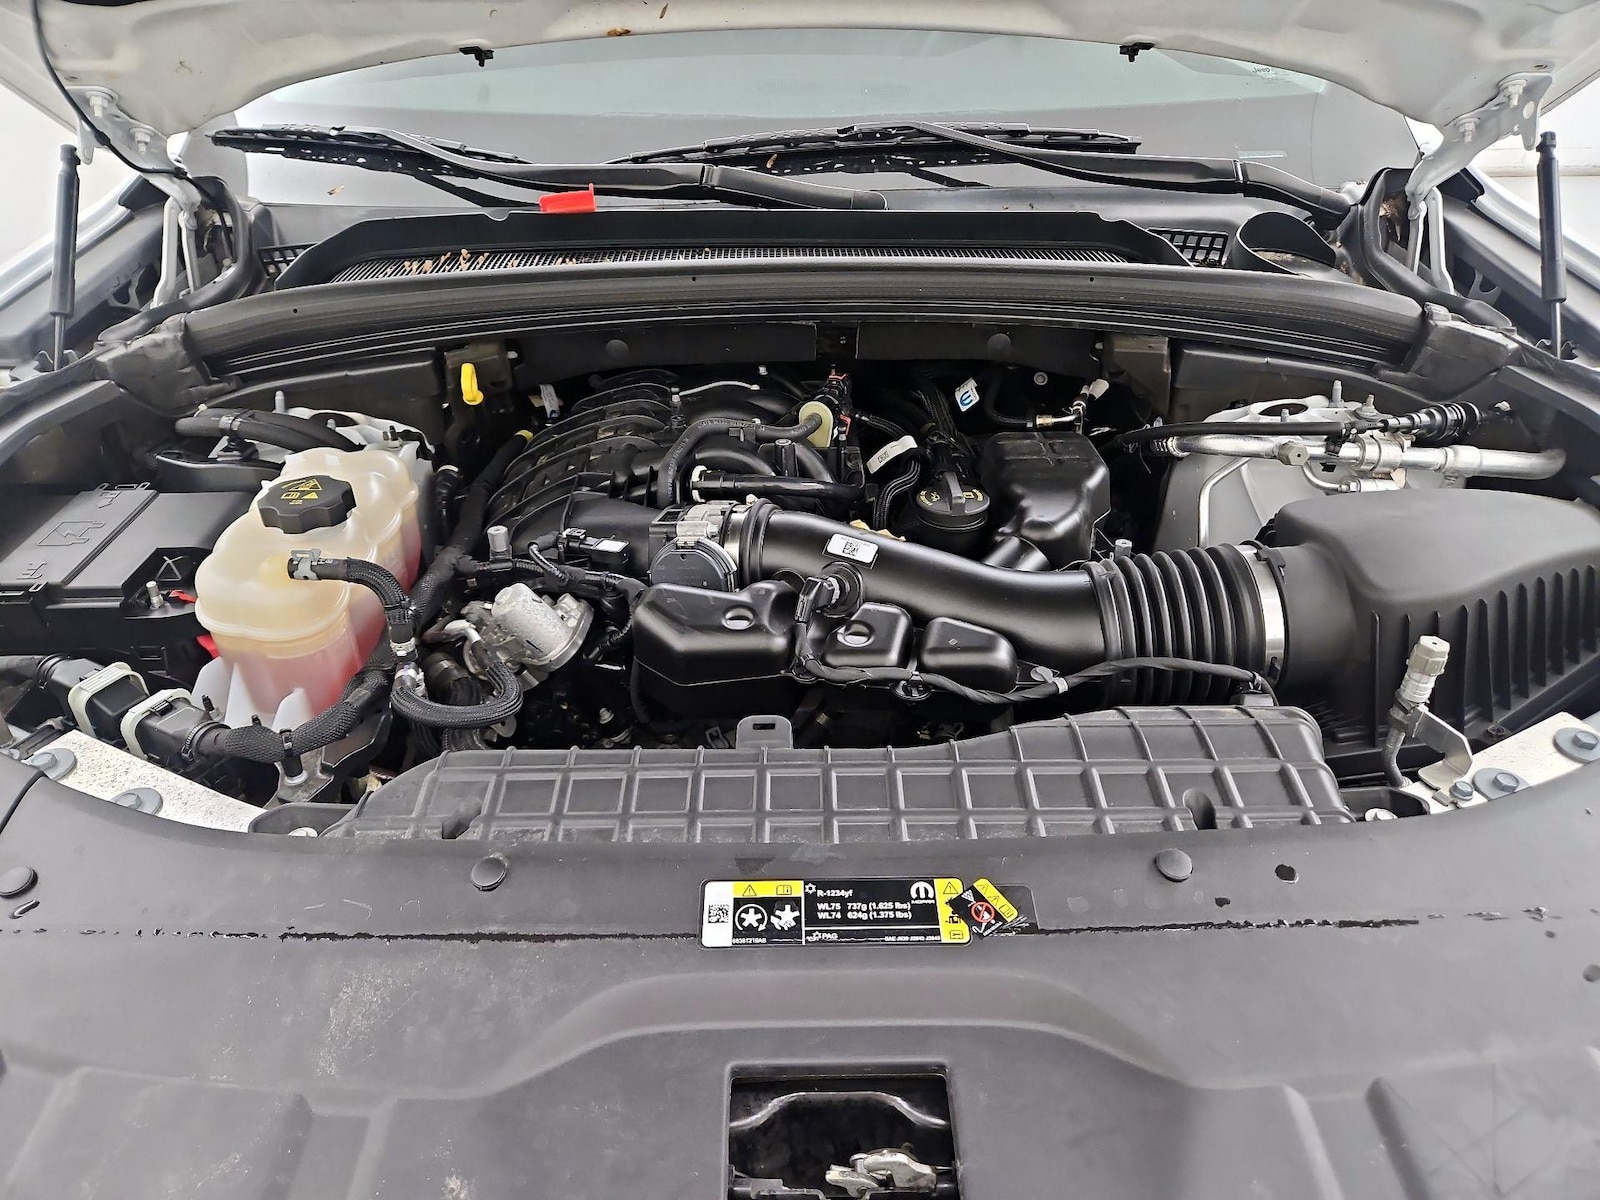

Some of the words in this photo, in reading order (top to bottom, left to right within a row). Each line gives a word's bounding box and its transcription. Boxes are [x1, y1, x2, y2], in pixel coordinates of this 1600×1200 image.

[817, 889, 853, 898] R-1234yf
[847, 903, 867, 911] 737g
[868, 902, 893, 911] (1.625
[895, 902, 911, 910] lbs)
[847, 911, 868, 920] 624g
[869, 911, 894, 920] (1.375
[896, 911, 912, 919] lbs)
